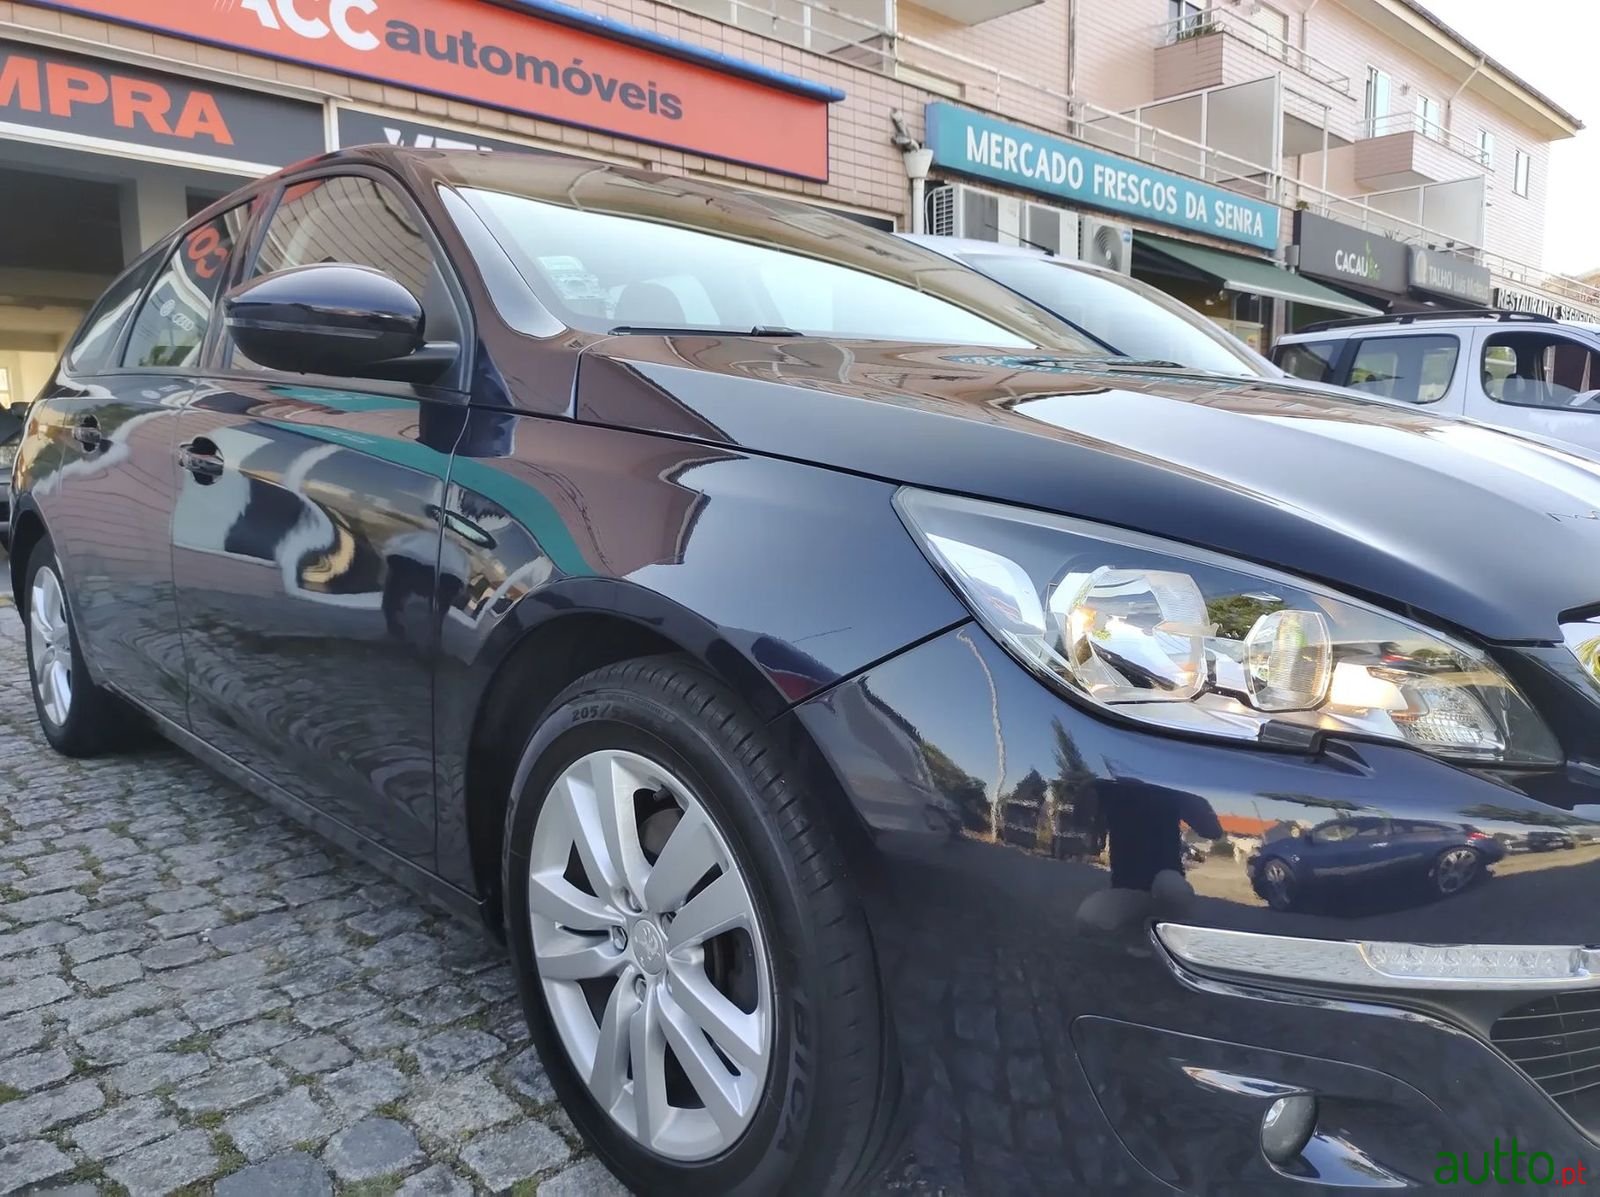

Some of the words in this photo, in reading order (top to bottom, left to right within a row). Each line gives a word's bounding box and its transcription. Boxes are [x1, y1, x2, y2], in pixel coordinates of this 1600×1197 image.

[385, 19, 683, 120] automóveis
[966, 126, 1084, 190] MERCADO
[1093, 165, 1177, 215] FRESCOS
[1185, 191, 1208, 223] DA
[1215, 201, 1264, 238] SENRA
[1497, 288, 1558, 320] RESTAURANTE
